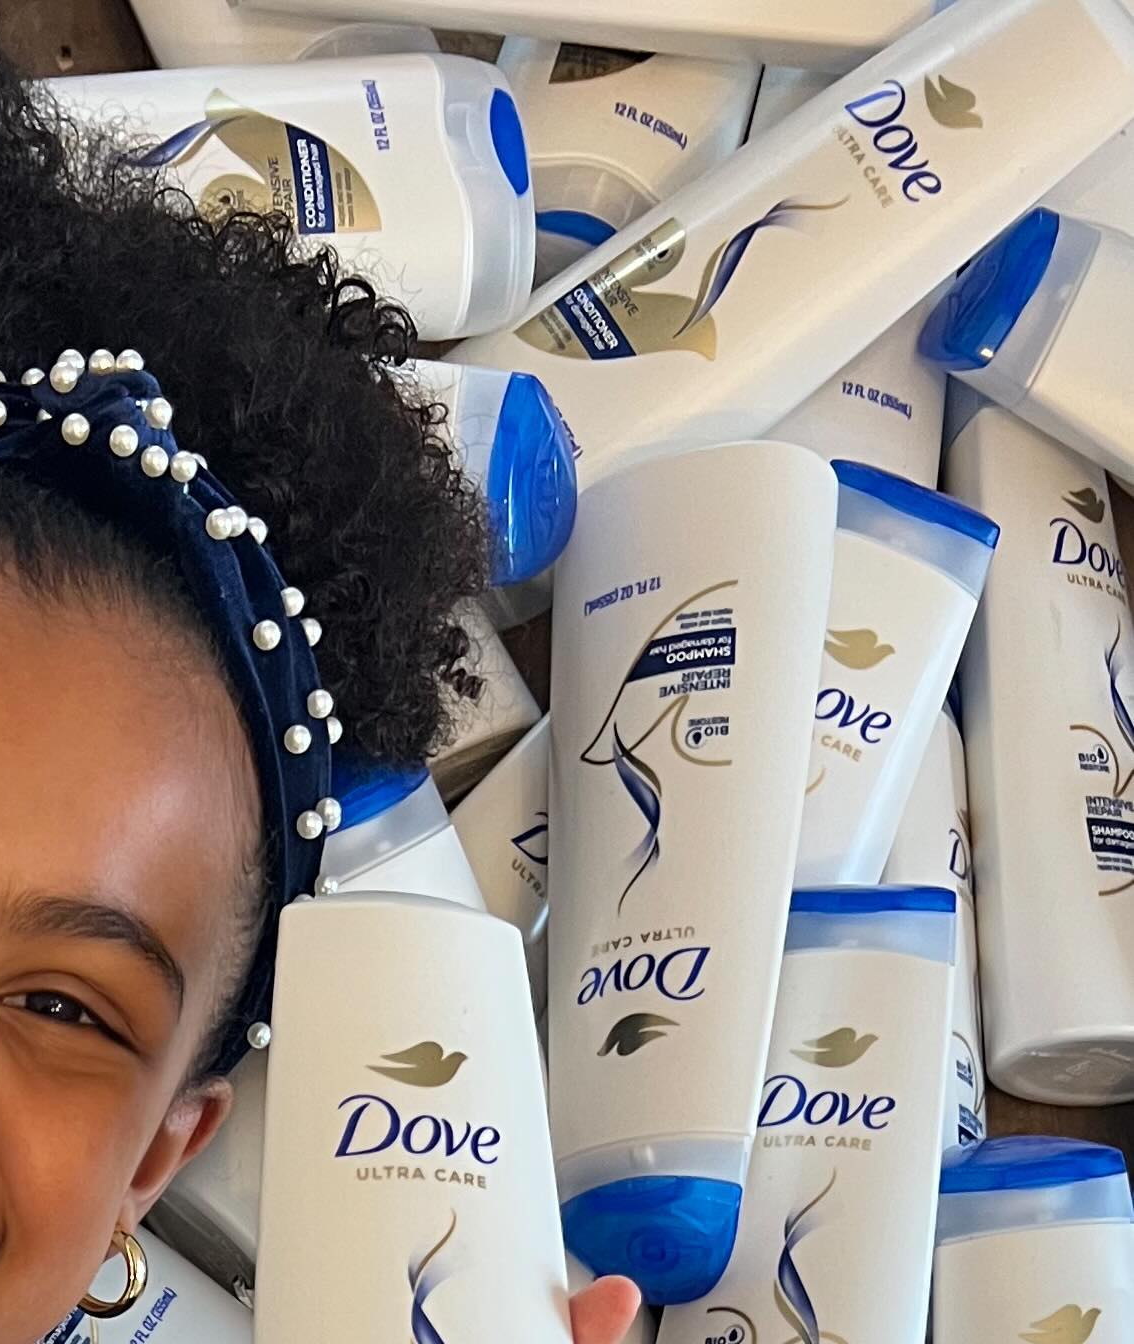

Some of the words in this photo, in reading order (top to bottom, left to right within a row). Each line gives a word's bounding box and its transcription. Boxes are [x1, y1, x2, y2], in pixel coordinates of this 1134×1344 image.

[844, 80, 942, 202] Dove
[296, 138, 316, 228] CONDITIONER
[574, 288, 618, 350] CONDITIONER
[842, 381, 854, 395] 12
[637, 580, 648, 594] FL
[649, 576, 661, 591] 12
[1066, 572, 1103, 592] ULTRA
[620, 584, 634, 600] OZ
[666, 646, 731, 664] SHAMPOO
[682, 668, 731, 683] REPAIR
[659, 679, 731, 698] INTENSIVE
[814, 688, 892, 744] ove
[704, 725, 730, 736] BIO
[820, 734, 862, 762] CARE
[1078, 752, 1098, 764] BIO
[641, 926, 696, 941] ULTRA
[577, 946, 711, 1006] Dove
[758, 1074, 896, 1130] Dove
[334, 1094, 500, 1164] Dove
[762, 1136, 818, 1149] ULTRA
[824, 1136, 872, 1152] CARE
[356, 1165, 424, 1182] ULTRA
[434, 1168, 487, 1190] CARE
[143, 1315, 157, 1331] OZ
